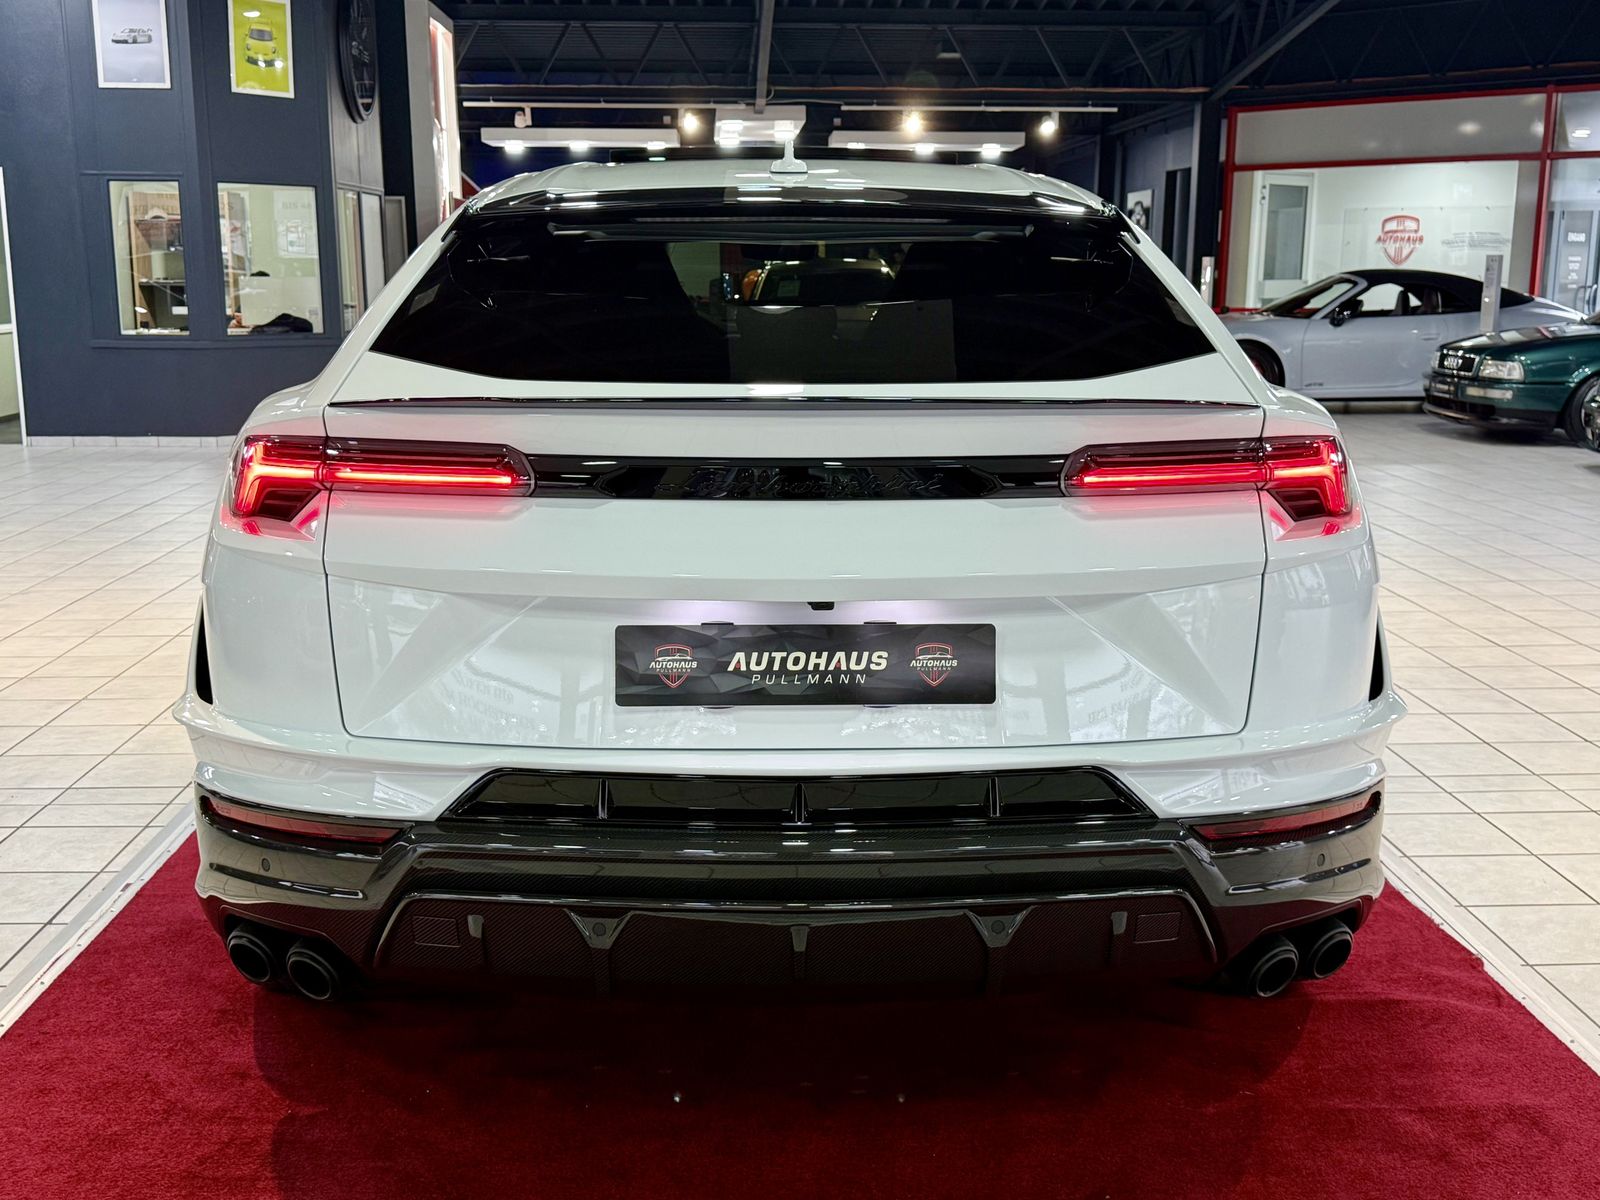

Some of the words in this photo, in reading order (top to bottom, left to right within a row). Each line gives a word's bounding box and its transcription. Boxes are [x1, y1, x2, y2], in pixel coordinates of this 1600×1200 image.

[1376, 234, 1425, 245] AUTOHAUS
[649, 661, 698, 669] AUTOHAUS
[727, 651, 889, 671] AUTOHAUS
[910, 659, 958, 667] AUTOHAUS
[751, 674, 867, 685] PULLMANN
